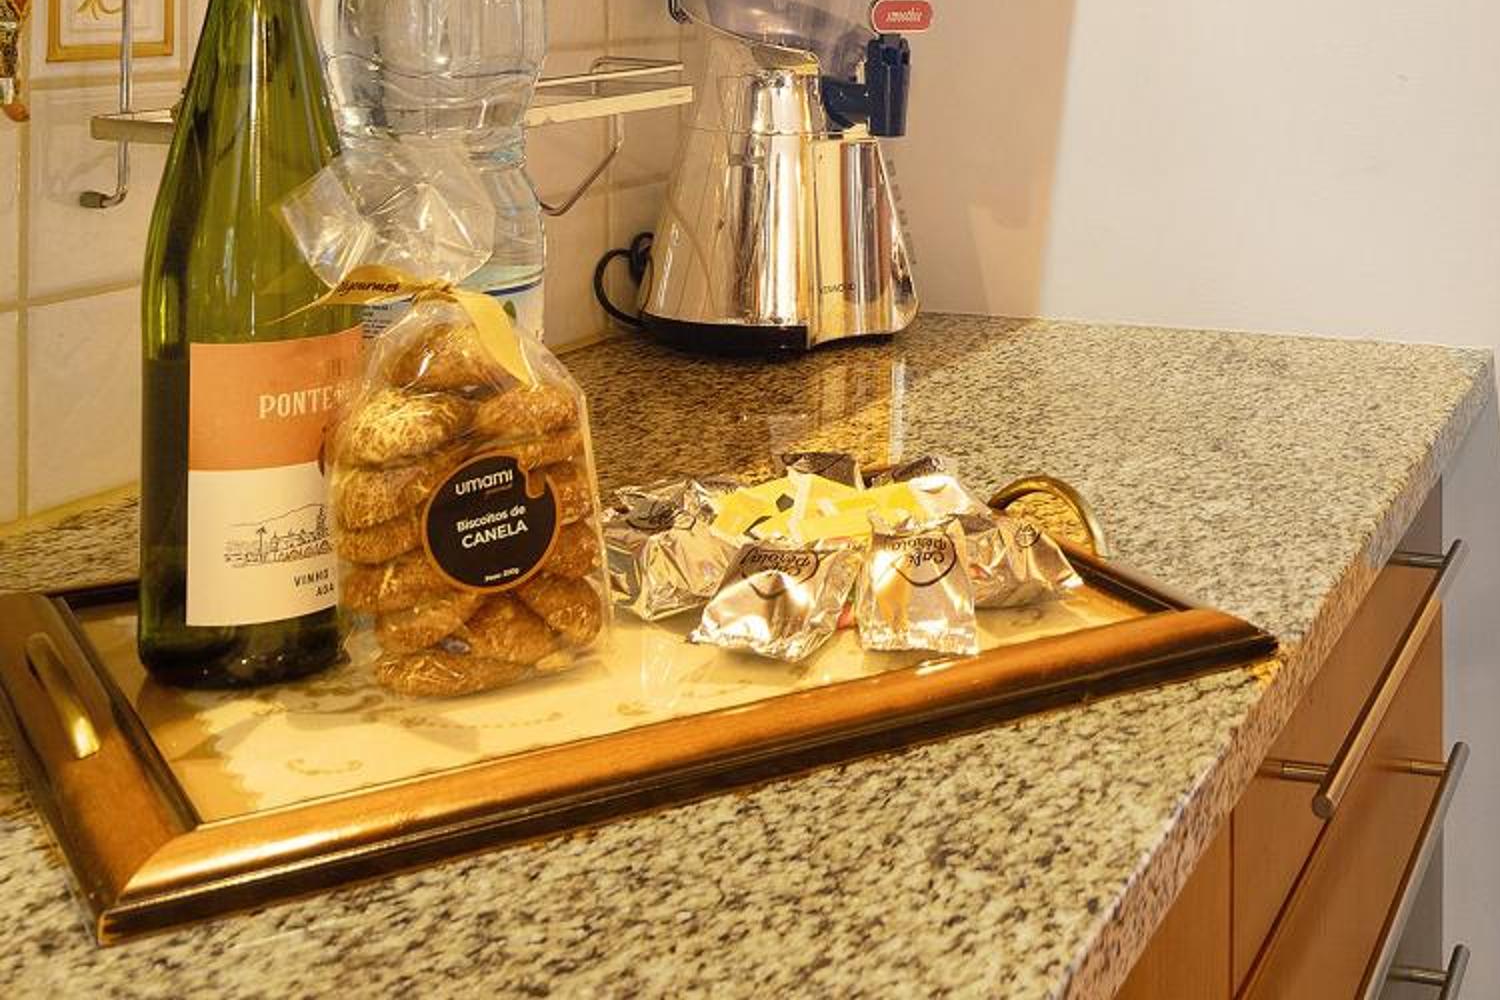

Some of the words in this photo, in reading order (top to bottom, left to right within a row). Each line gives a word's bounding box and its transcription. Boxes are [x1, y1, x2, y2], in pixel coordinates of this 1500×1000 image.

[258, 386, 334, 420] PONTE
[455, 469, 514, 496] umami
[456, 510, 508, 533] Biscoitos
[509, 504, 527, 519] de
[461, 519, 529, 549] CANELA
